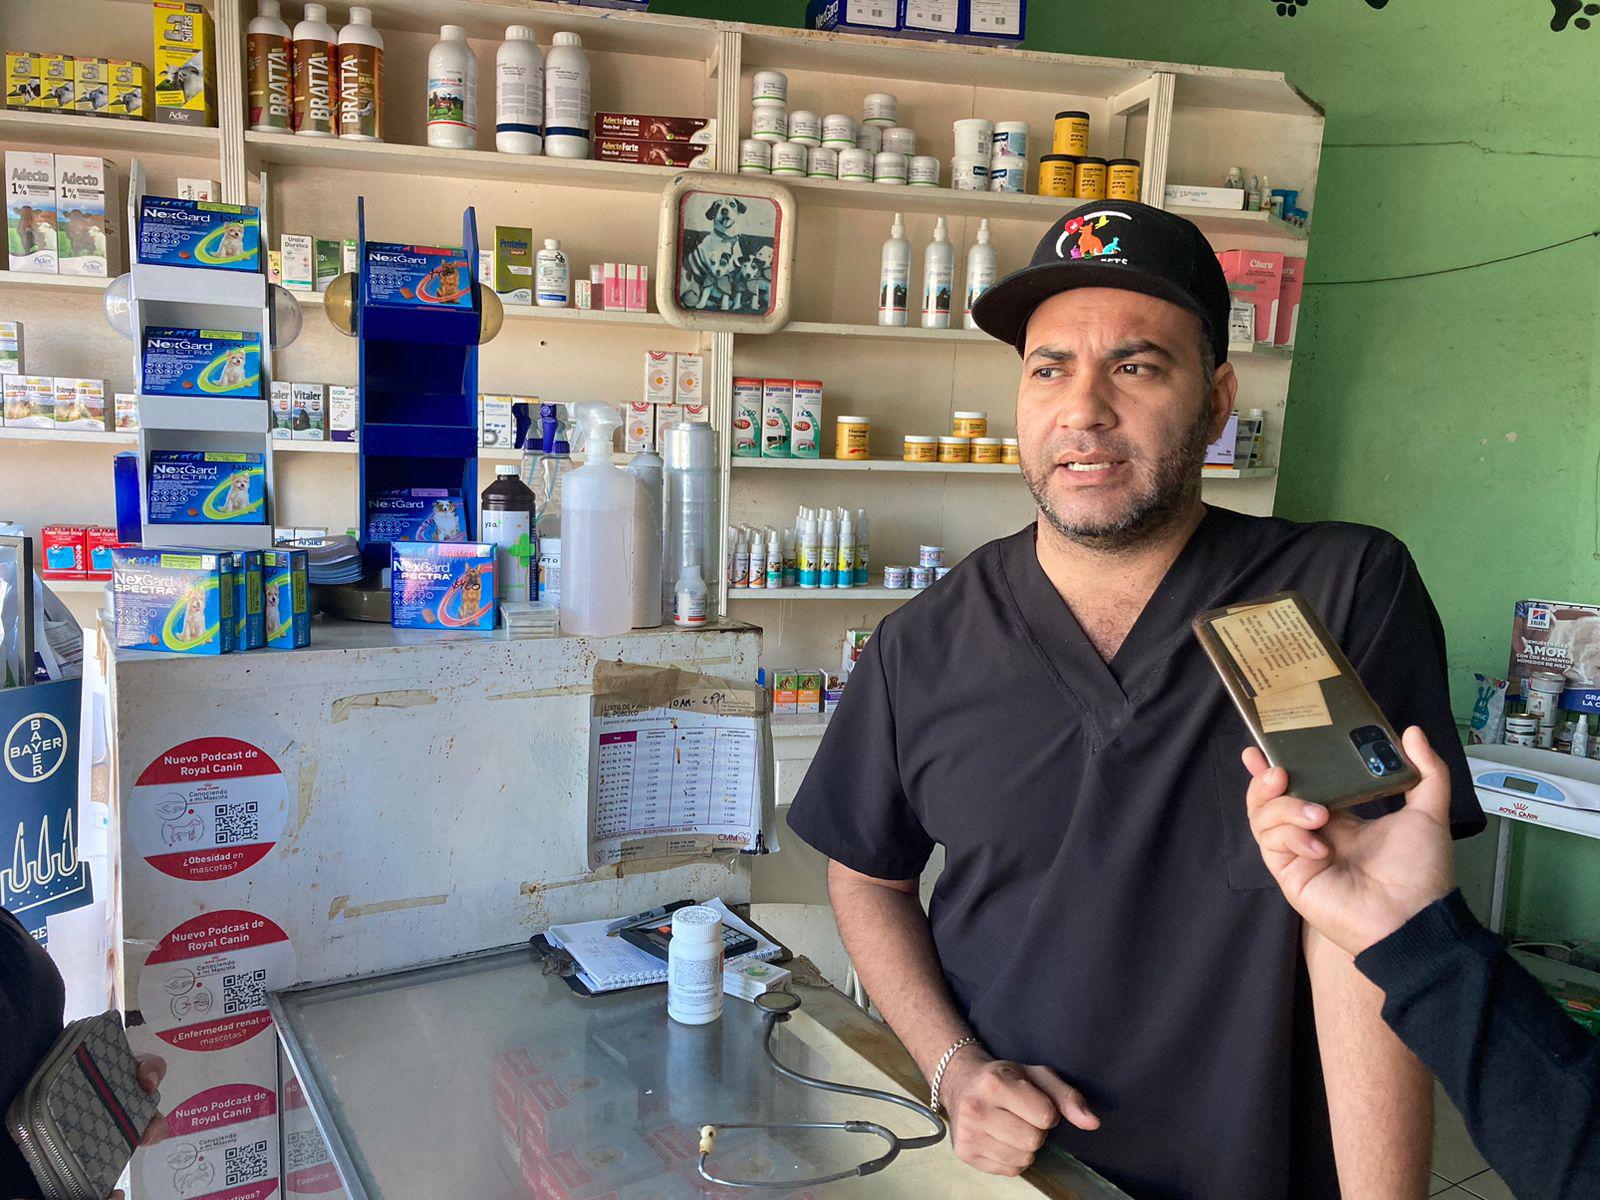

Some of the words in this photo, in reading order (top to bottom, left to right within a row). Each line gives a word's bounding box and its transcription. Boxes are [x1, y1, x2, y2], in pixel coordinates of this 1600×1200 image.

[268, 52, 289, 116] BRATTA
[308, 57, 330, 120] BRATTA
[341, 58, 358, 123] BRATTA
[12, 168, 49, 183] Adecto
[62, 172, 99, 187] Adecto
[11, 183, 27, 196] 1%
[61, 187, 77, 199] 1%
[143, 209, 211, 222] NexGard
[369, 253, 427, 265] NexGard
[147, 339, 213, 350] NexGard
[293, 390, 322, 400] Vitaler
[153, 465, 217, 475] NexGard
[393, 560, 450, 574] NexGard
[114, 571, 174, 586] NexGard
[114, 584, 176, 595] SPECTRA
[1524, 645, 1567, 659] AMOR
[1541, 656, 1574, 665] ALIMENTOS
[10, 737, 62, 759] BAYER
[31, 719, 43, 776] BAYER
[164, 755, 198, 766] Nuevo
[201, 751, 243, 762] Podcast
[245, 750, 258, 758] de
[180, 764, 211, 777] Royal
[213, 763, 243, 774] Canin
[203, 794, 228, 802] Mascota
[1499, 806, 1519, 816] ROYAL
[1519, 811, 1539, 820] CANIN
[718, 834, 738, 842] CMM
[182, 852, 231, 868] ¿Obesidad
[189, 861, 238, 875] mascotas?
[172, 931, 206, 942] Nuevo
[208, 922, 250, 937] Podcast
[251, 920, 265, 928] de
[188, 939, 218, 951] Royal
[220, 934, 250, 946] Canin
[172, 1022, 234, 1043] ¿Enfermedad
[236, 1017, 260, 1029] renal
[261, 1015, 273, 1023] en
[200, 1030, 247, 1046] mascotas?
[175, 1105, 208, 1118] Nuevo
[211, 1094, 253, 1111] Podcast
[254, 1091, 266, 1101] de
[191, 1113, 220, 1127] Royal
[222, 1106, 252, 1119] Canin
[198, 1132, 237, 1146] Conociendo
[213, 1137, 237, 1147] Mascota
